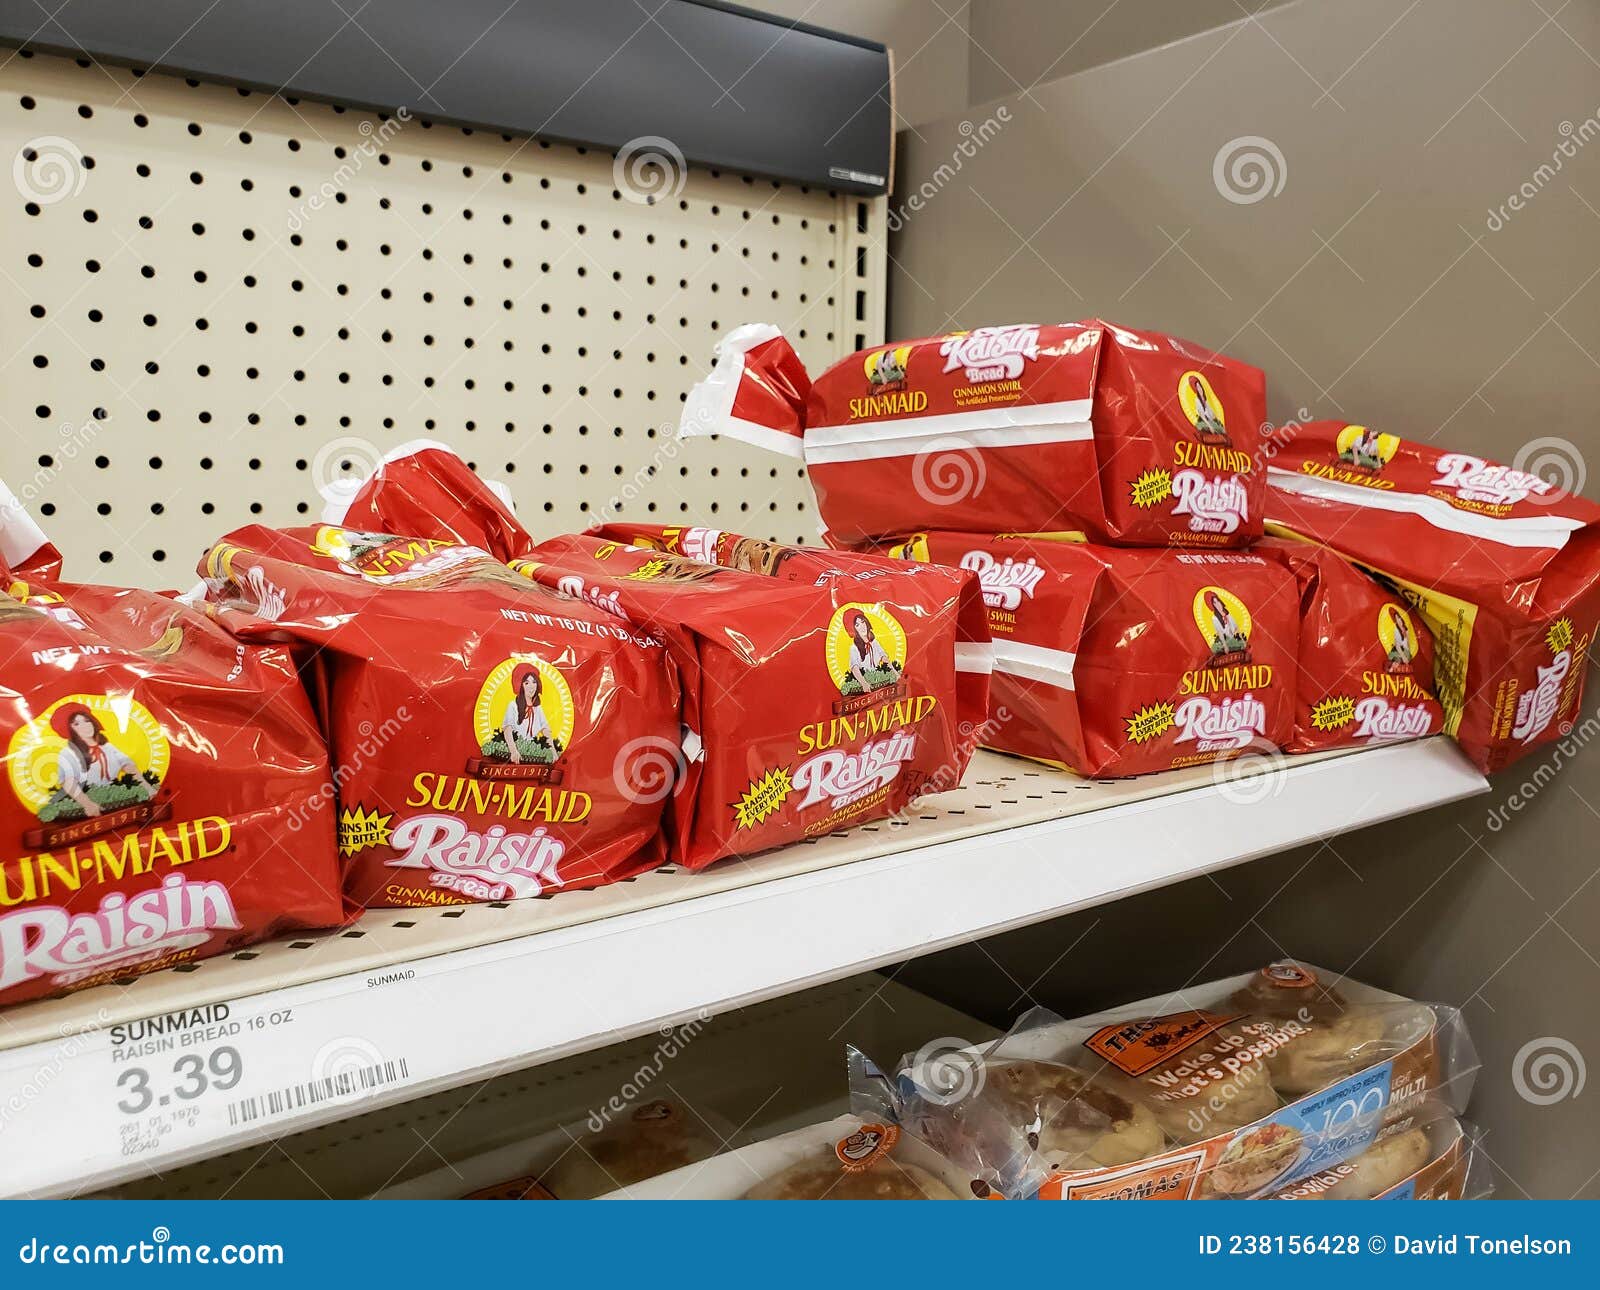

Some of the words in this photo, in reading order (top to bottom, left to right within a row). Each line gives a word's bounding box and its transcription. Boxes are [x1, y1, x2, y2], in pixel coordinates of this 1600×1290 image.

[953, 385, 997, 399] CINNAMON
[998, 381, 1022, 393] SWIRL
[965, 366, 1006, 383] Bread
[1430, 453, 1553, 504] Raisin
[1171, 469, 1248, 530] Raisin
[500, 608, 529, 623] NET
[530, 613, 554, 627] WT
[556, 617, 574, 631] 16
[576, 621, 595, 636] OZ
[990, 611, 1017, 624] SWIRL
[32, 645, 74, 665] NET
[79, 645, 112, 656] WT
[1173, 693, 1266, 748] Raisin
[1352, 696, 1432, 738] Raisin
[481, 766, 518, 777] SINCE
[522, 767, 550, 777] 1912
[791, 731, 917, 811] Raisin
[743, 785, 773, 812] RAISINS
[773, 776, 782, 786] IN
[746, 801, 769, 820] EVERY
[831, 781, 878, 811] Bread
[50, 820, 102, 844] SINCE
[110, 807, 150, 827] 1912
[365, 821, 378, 831] IN
[384, 813, 566, 898] Raisin
[429, 872, 505, 900] Bread
[0, 872, 244, 991] Raisin
[367, 970, 416, 988] SUNMAID
[110, 1003, 230, 1045] SUNMAID
[112, 1037, 174, 1063] RAISIN
[181, 1022, 241, 1048] BREAD
[247, 1016, 265, 1032] 16
[272, 1009, 294, 1026] OZ
[1149, 1052, 1216, 1089] Wake
[1213, 1034, 1245, 1053] up
[116, 1045, 243, 1115] 3.39
[1389, 1075, 1426, 1105] MULTI
[1318, 1087, 1384, 1145] 100
